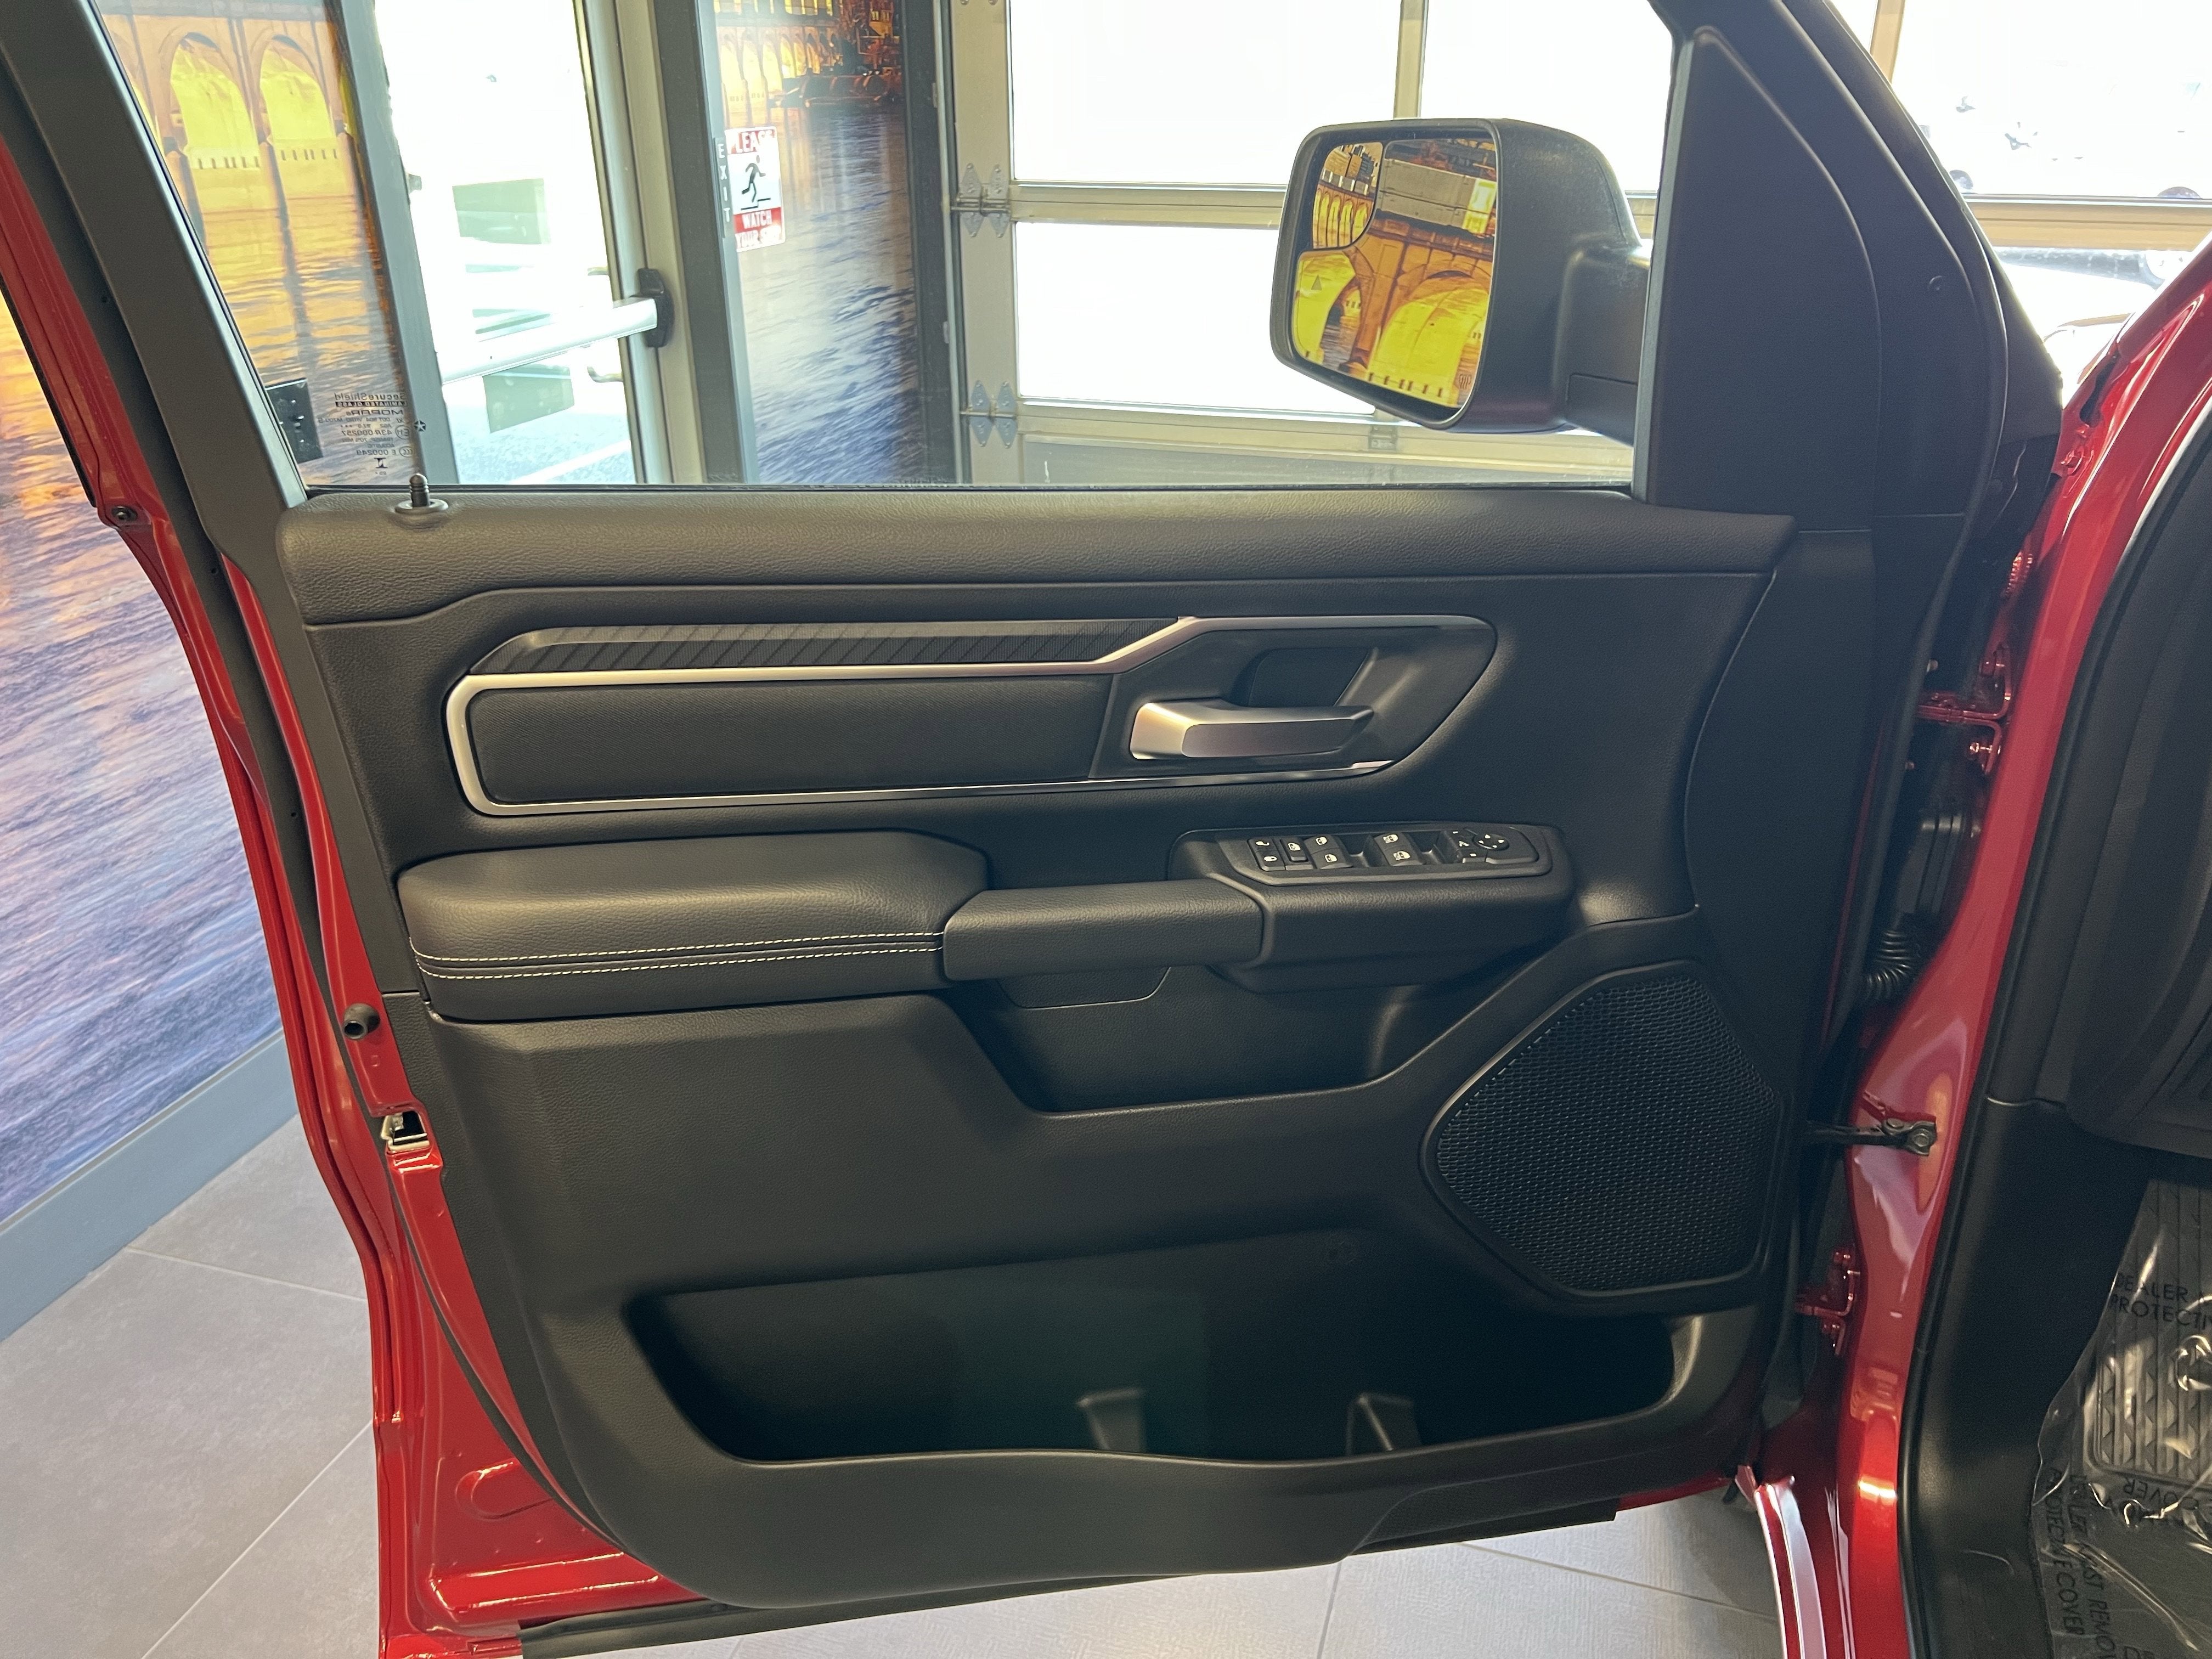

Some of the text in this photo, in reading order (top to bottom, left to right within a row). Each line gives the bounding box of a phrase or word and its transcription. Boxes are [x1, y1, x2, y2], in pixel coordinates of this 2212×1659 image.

[717, 143, 731, 223] EXIT
[742, 210, 772, 229] WATCH
[2115, 1272, 2188, 1303] DEALER
[2056, 1572, 2085, 1635] COVER
